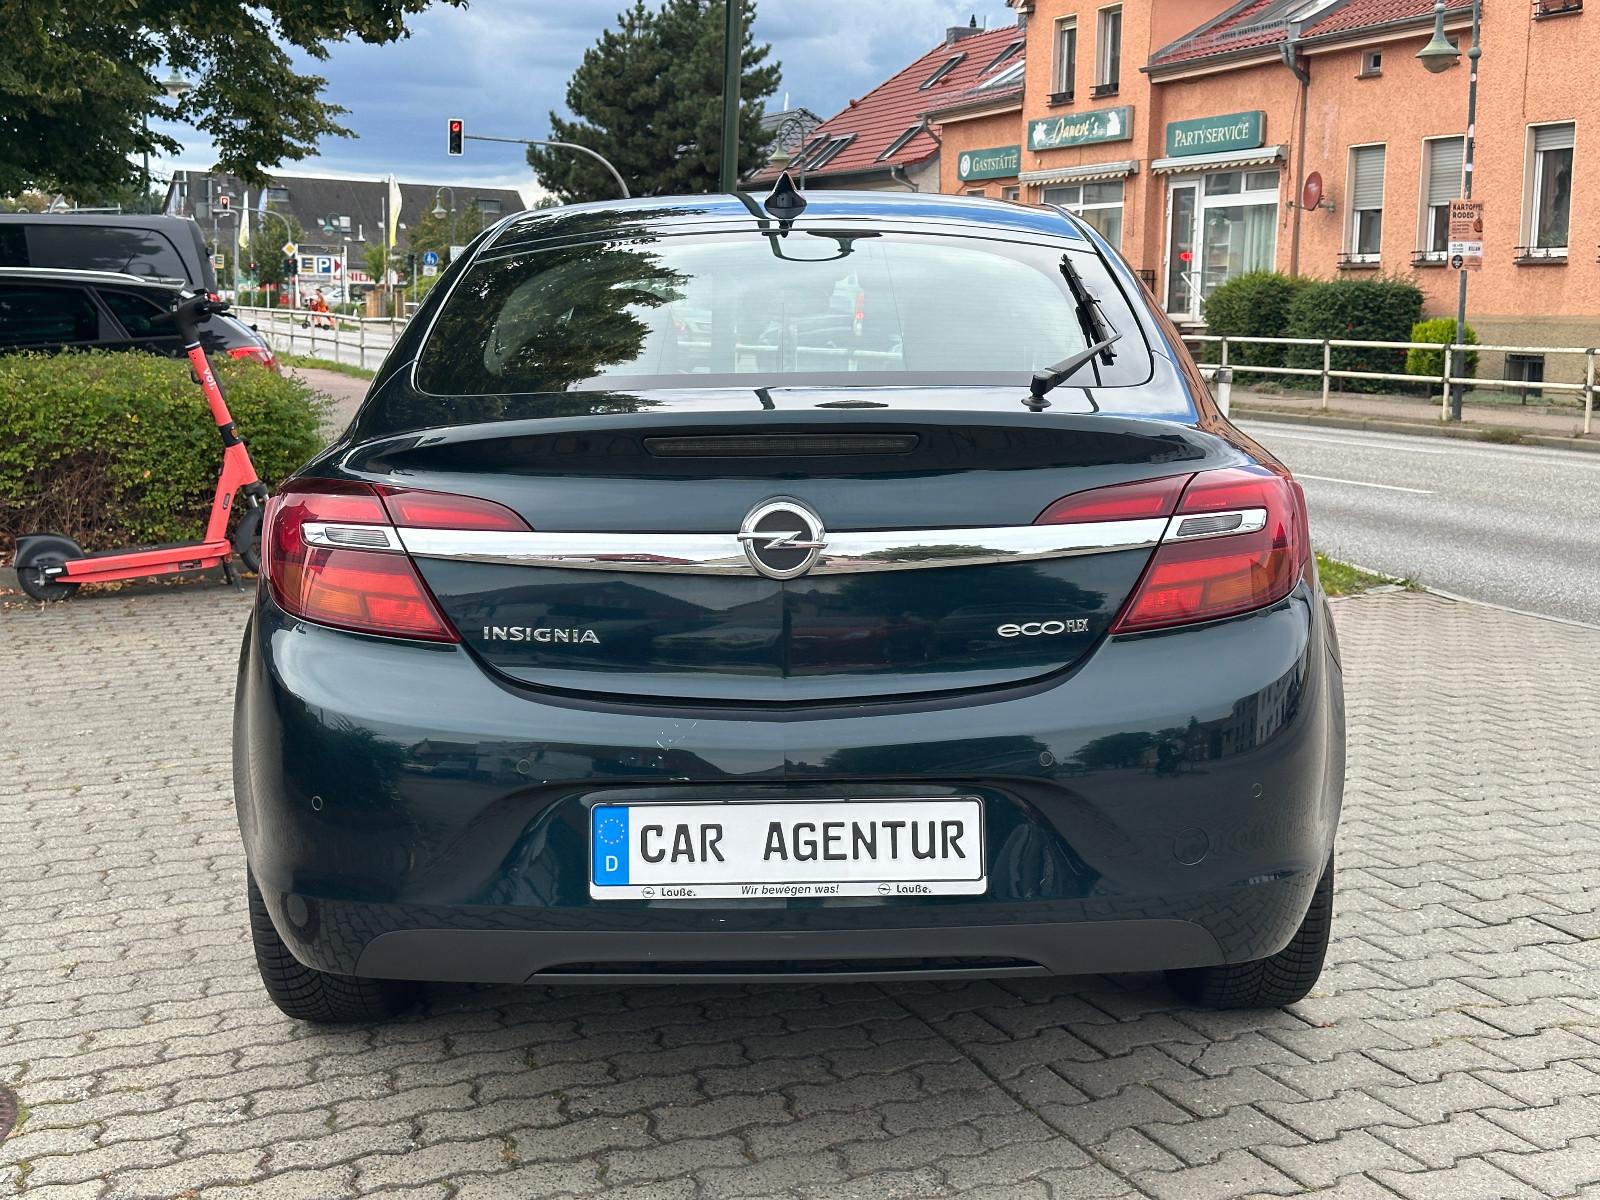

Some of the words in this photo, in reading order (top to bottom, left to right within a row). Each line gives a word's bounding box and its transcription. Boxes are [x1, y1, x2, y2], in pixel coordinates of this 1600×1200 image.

[1174, 122, 1249, 147] PARTYSERVICE
[1452, 211, 1475, 219] RODEO
[483, 626, 600, 644] INSIGNIA
[640, 823, 725, 863] CAR
[763, 820, 966, 861] AGENTUR
[605, 855, 618, 872] D
[741, 885, 759, 895] Wir
[761, 884, 811, 897] bewegen
[814, 884, 839, 894] was!
